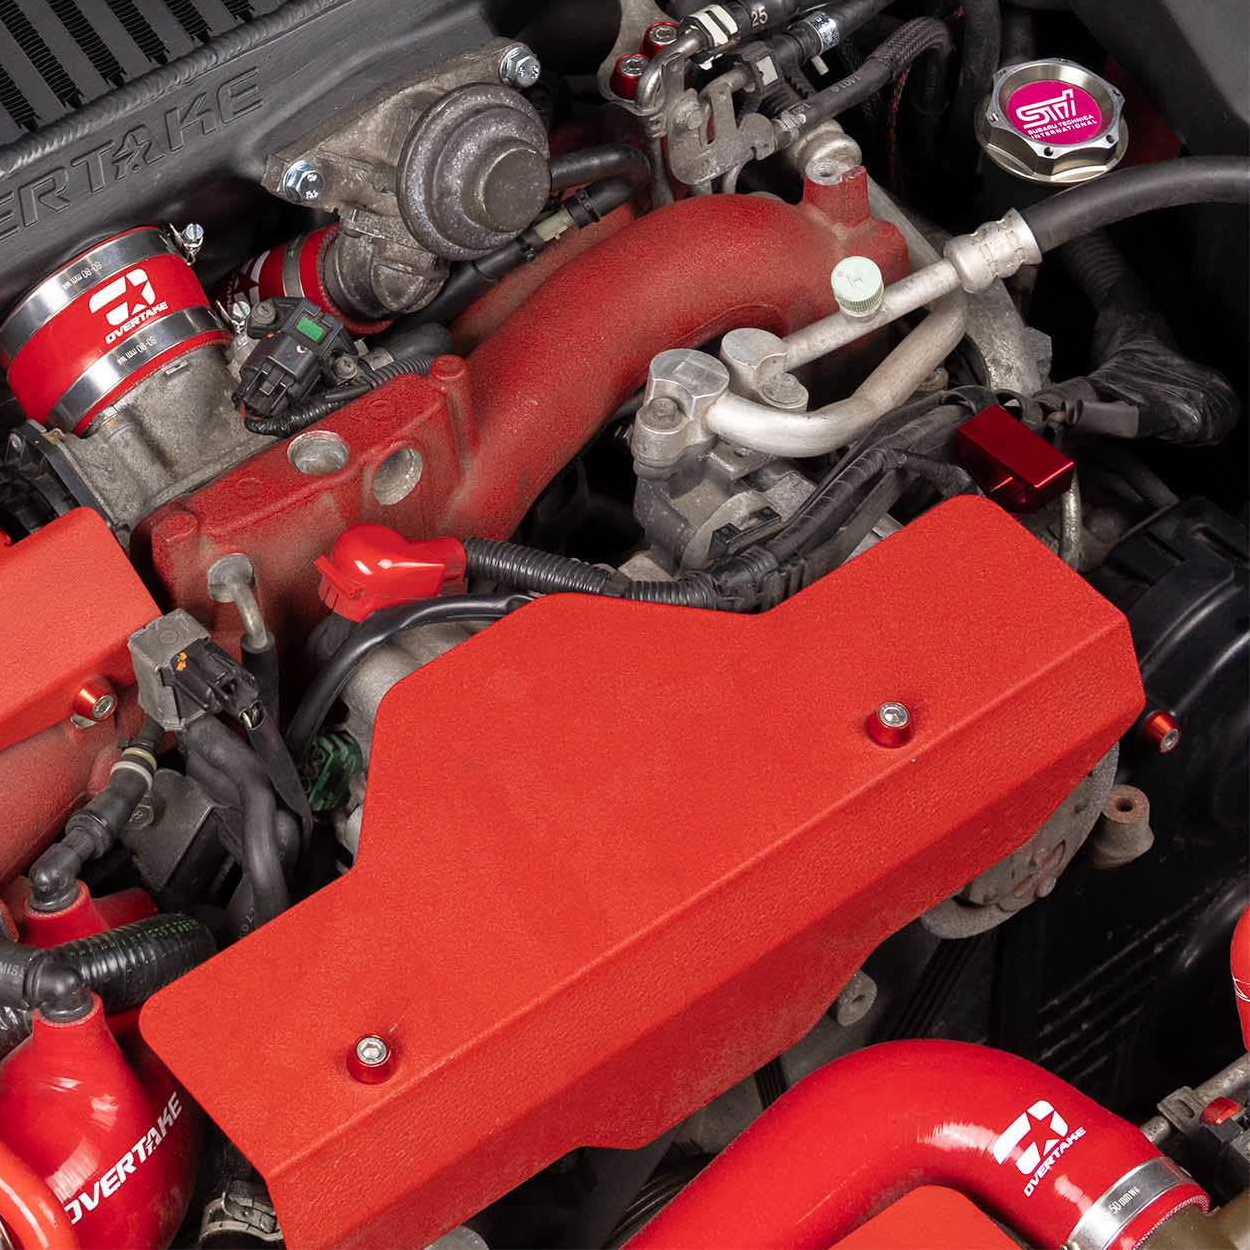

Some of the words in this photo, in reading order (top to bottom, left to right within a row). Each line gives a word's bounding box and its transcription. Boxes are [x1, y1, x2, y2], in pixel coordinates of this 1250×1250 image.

[750, 6, 768, 27] 25
[1028, 124, 1057, 135] SUBARU
[1058, 114, 1094, 127] TECHNICA
[1030, 120, 1098, 139] INTERNATIONAL
[105, 301, 168, 344] OVERTAKE
[1023, 1126, 1087, 1198] OVERTAKE
